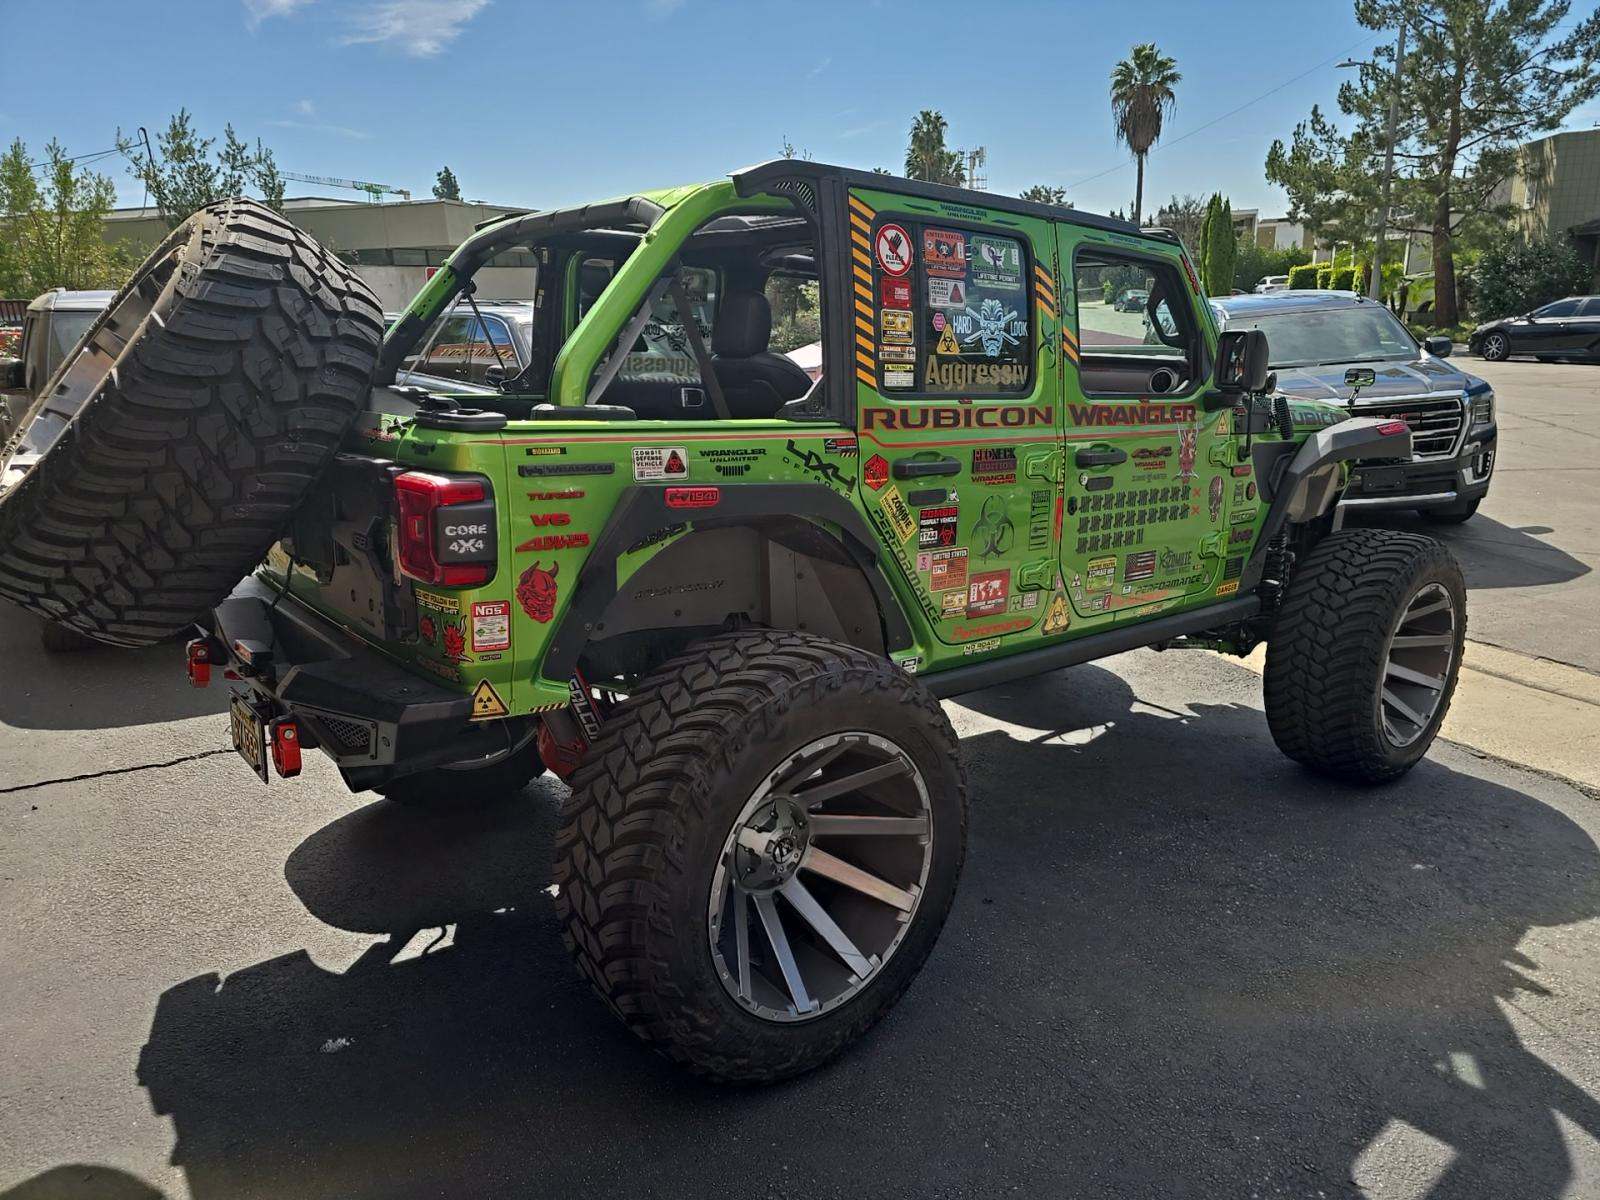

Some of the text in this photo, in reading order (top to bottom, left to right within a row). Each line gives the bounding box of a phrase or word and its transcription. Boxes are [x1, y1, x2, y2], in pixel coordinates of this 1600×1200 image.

[952, 315, 972, 334] HARD
[1009, 321, 1028, 337] LOOK
[862, 406, 1053, 430] RUBICON
[1069, 404, 1196, 426] WRANGLER
[699, 448, 767, 457] WRANGLER
[971, 474, 1016, 482] WRANGLER
[690, 490, 717, 501] 1941
[530, 513, 571, 526] V6
[891, 494, 913, 530] ZOMBIE
[445, 524, 487, 536] CORE
[873, 508, 942, 626] PERFORMANCE
